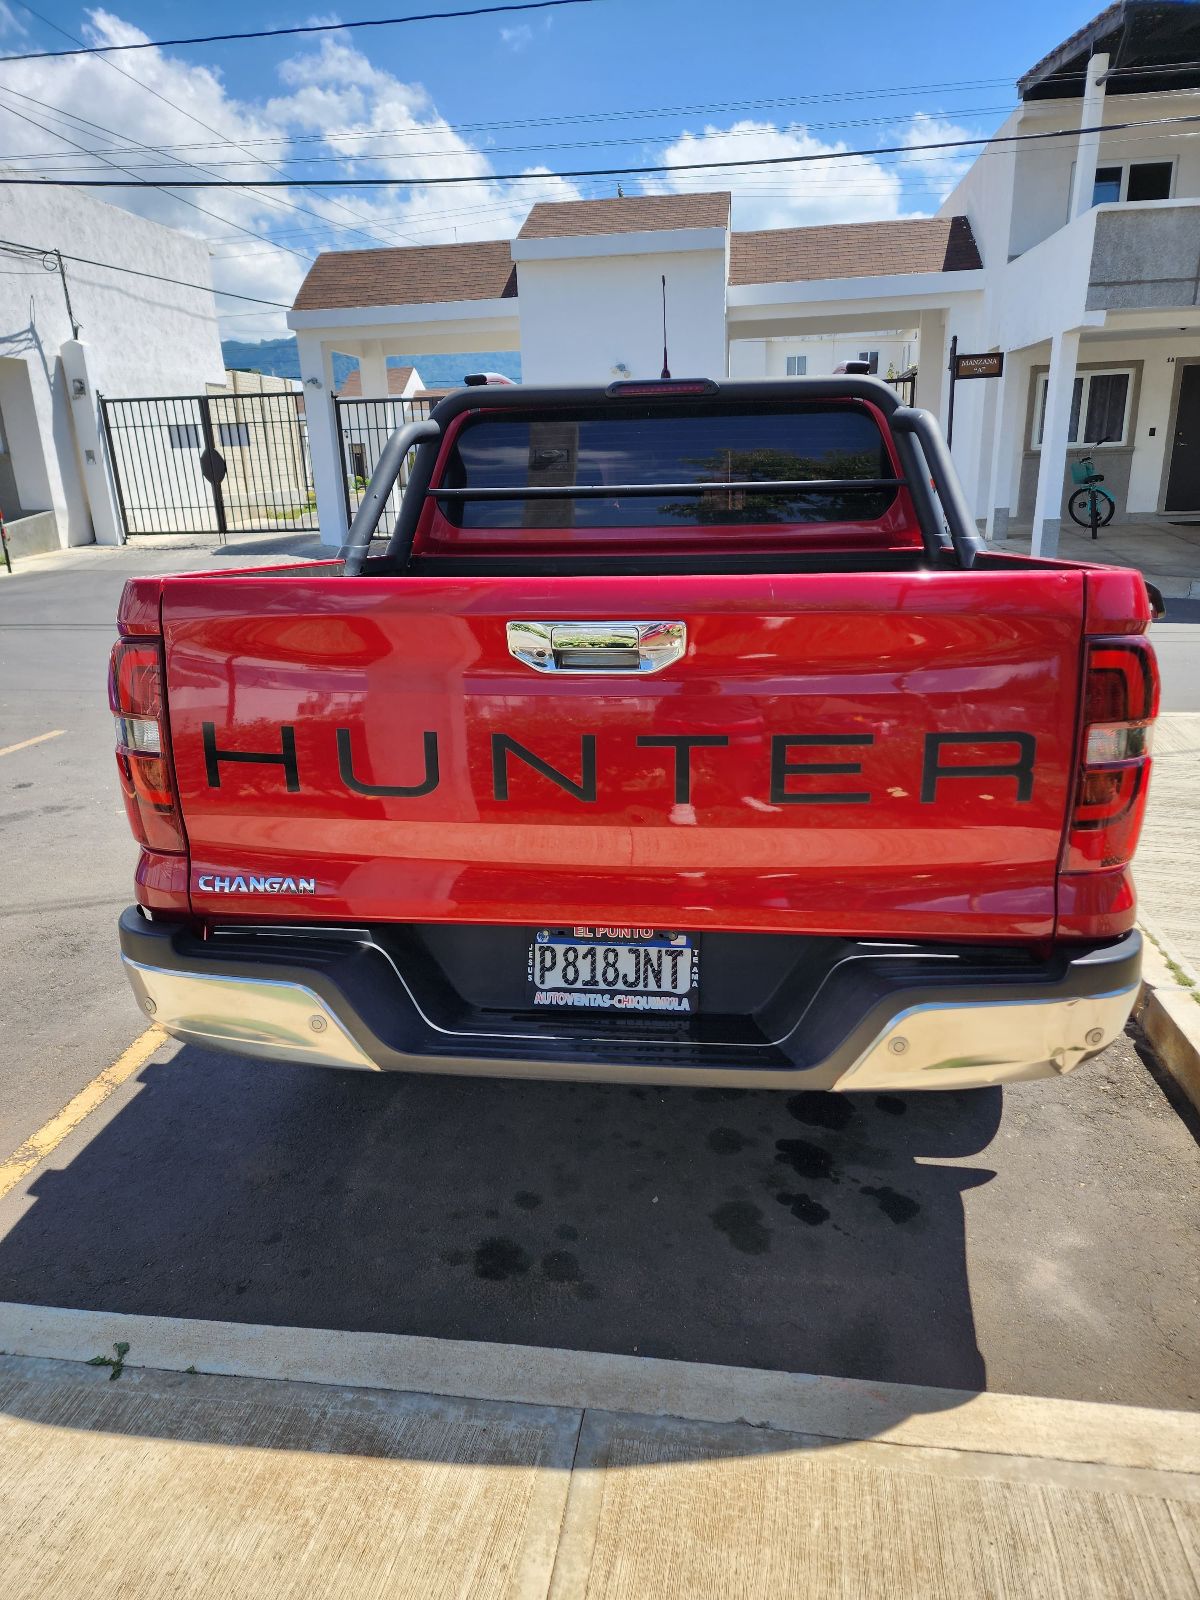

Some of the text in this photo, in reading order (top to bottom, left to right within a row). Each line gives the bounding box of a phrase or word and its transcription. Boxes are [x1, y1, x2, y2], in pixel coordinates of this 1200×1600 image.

[961, 358, 997, 366] MANZANA
[202, 722, 1037, 805] HUNTER
[198, 875, 315, 895] CHANGAN
[573, 926, 654, 939] EL PUNTO
[538, 945, 684, 990] P818JNT
